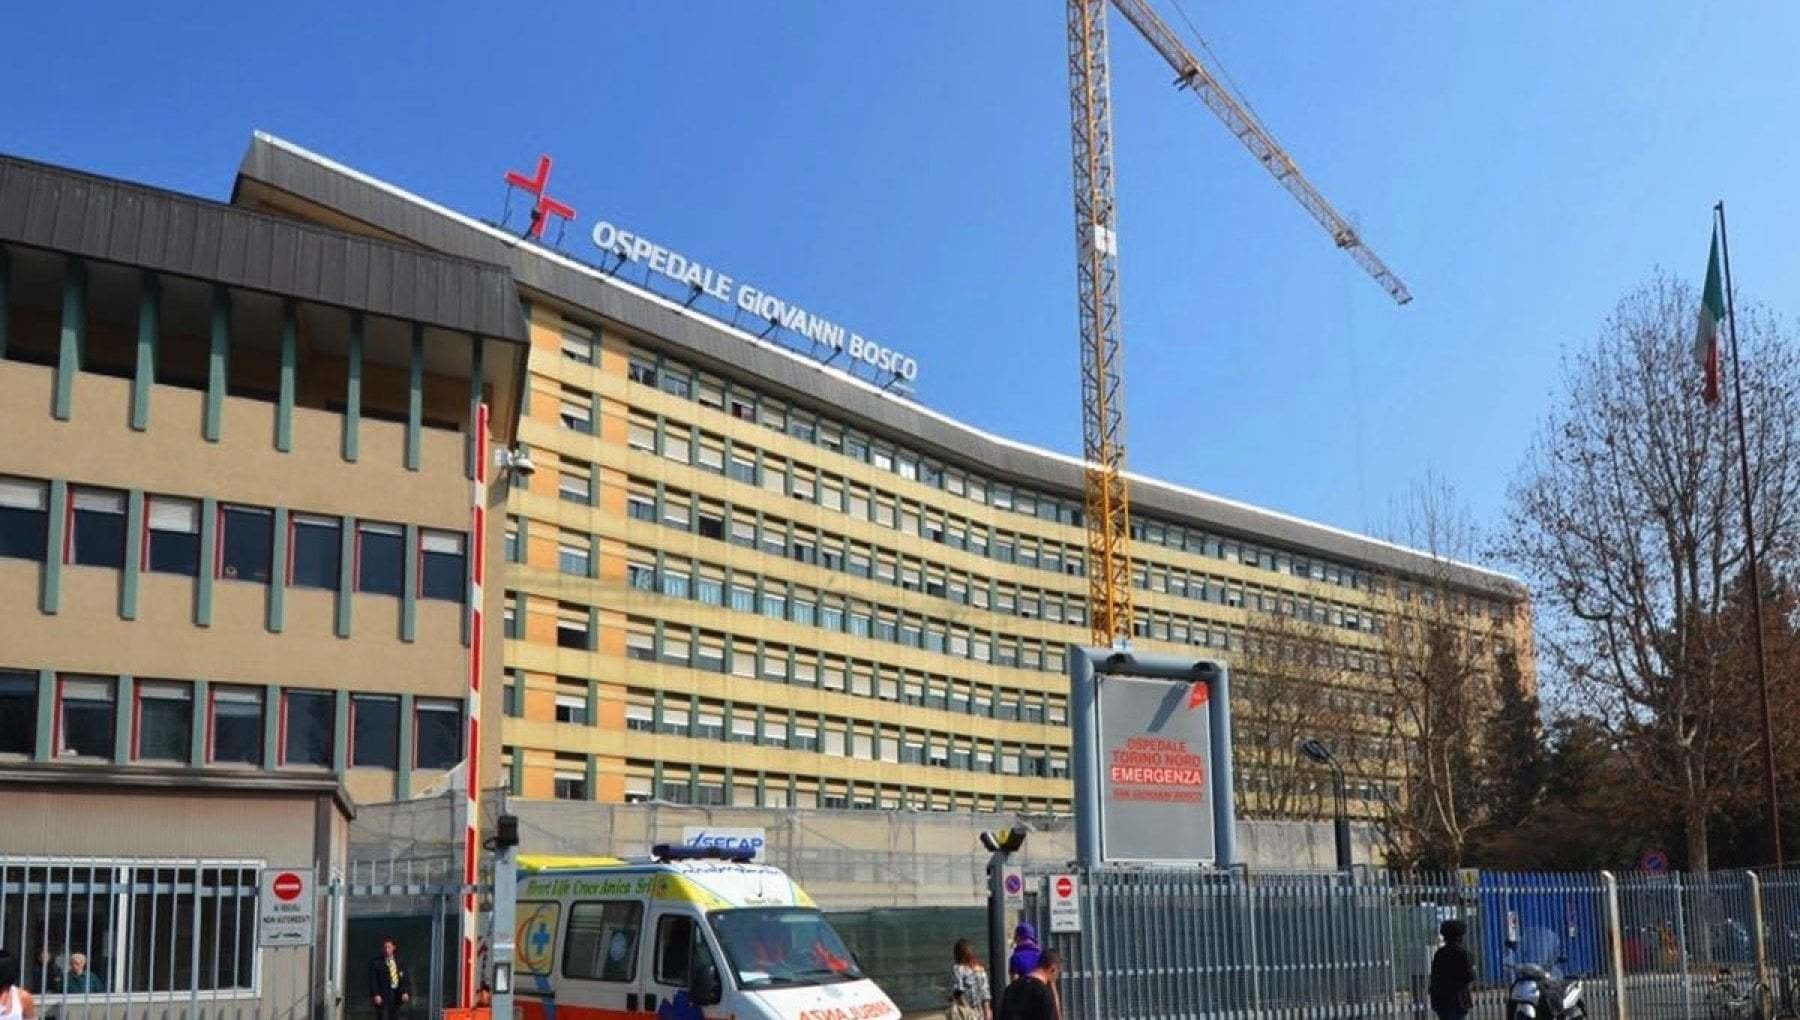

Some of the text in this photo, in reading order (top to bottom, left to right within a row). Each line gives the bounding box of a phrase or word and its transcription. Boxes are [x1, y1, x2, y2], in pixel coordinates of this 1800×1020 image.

[593, 221, 917, 380] OSPEDALE GIOVANNI BOSCO
[1127, 739, 1186, 752] OSPEDALE
[1112, 751, 1202, 768] TORINO NORD
[1111, 767, 1202, 785] EMERGENZA
